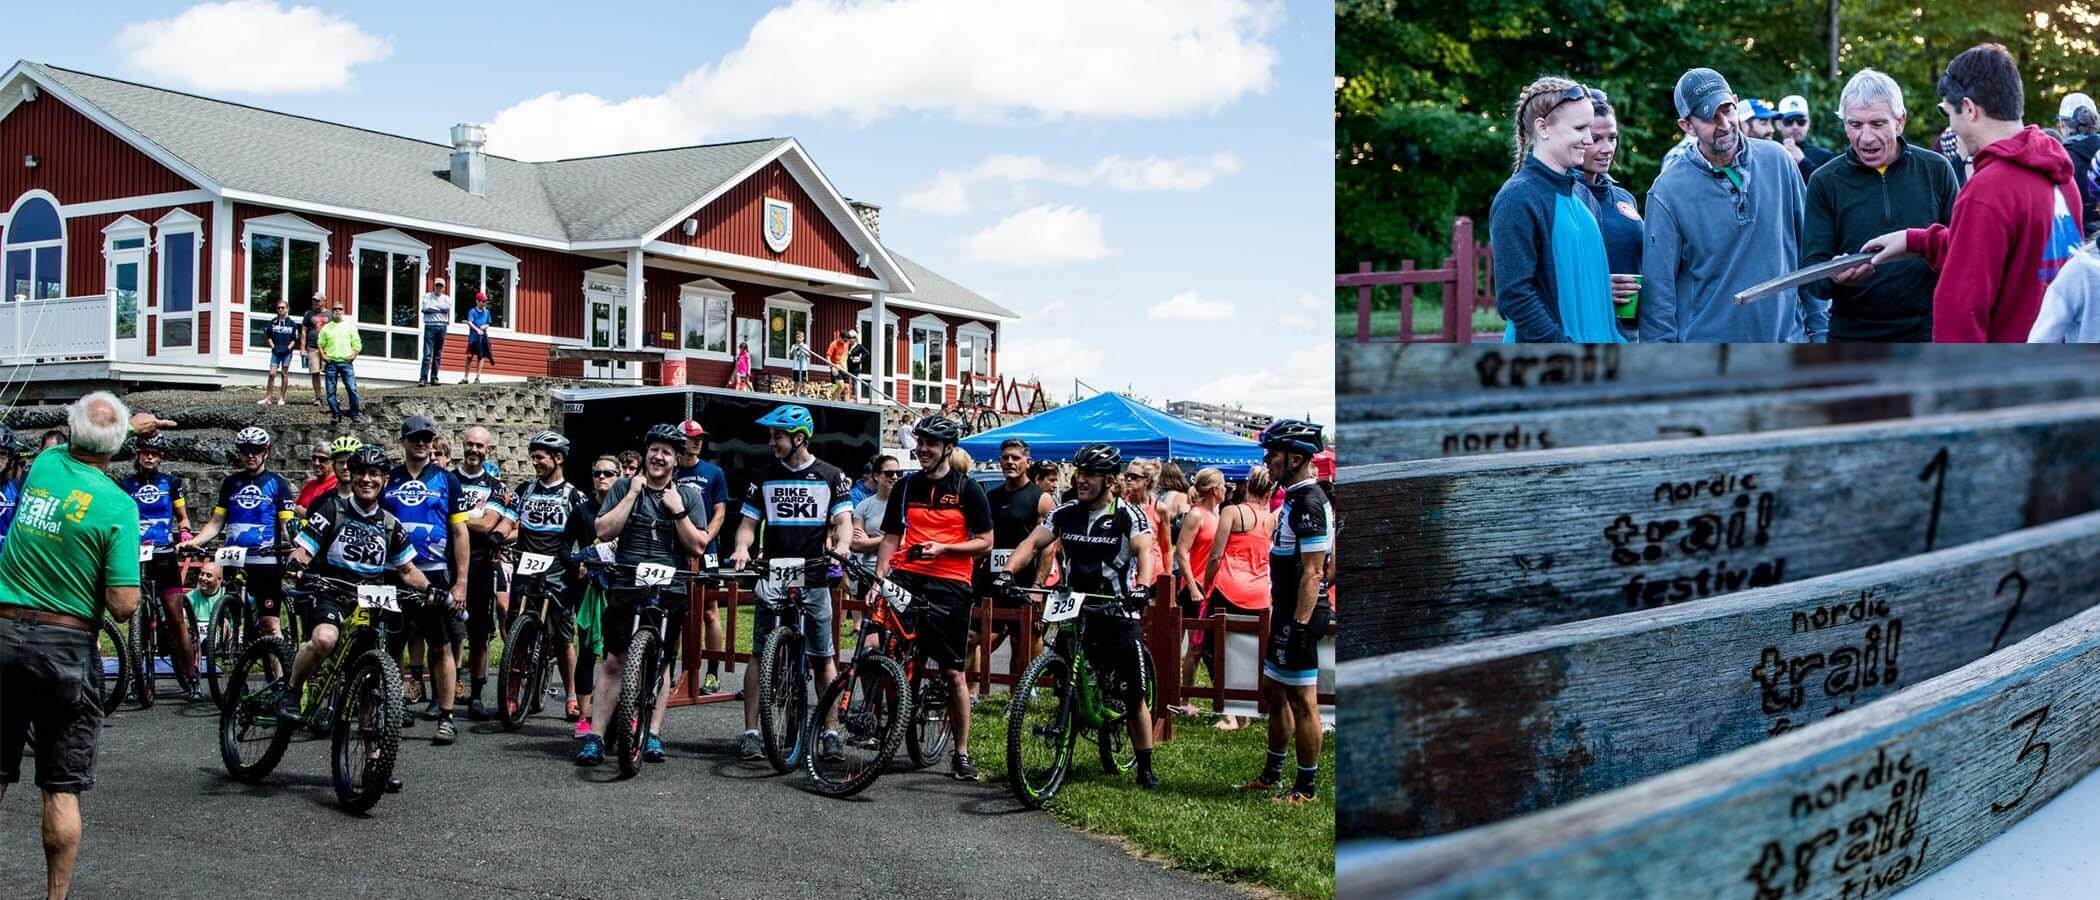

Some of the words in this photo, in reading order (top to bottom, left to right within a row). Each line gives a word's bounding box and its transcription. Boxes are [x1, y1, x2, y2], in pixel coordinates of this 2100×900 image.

[1441, 424, 1553, 451] nordic
[774, 487, 808, 497] BIKE
[1654, 473, 1757, 502] nordic
[1919, 446, 1949, 551] 1
[771, 496, 805, 504] BOARD
[806, 495, 816, 504] &
[776, 502, 818, 519] SKI
[528, 510, 564, 525] SKI
[342, 544, 385, 567] SKI
[525, 558, 545, 571] 321
[643, 567, 667, 579] 341
[1624, 557, 1788, 606] festival
[1051, 598, 1076, 615] 329
[1790, 589, 1890, 634] nordic
[1990, 703, 2052, 816] 3
[1790, 746, 1913, 818] nordic
